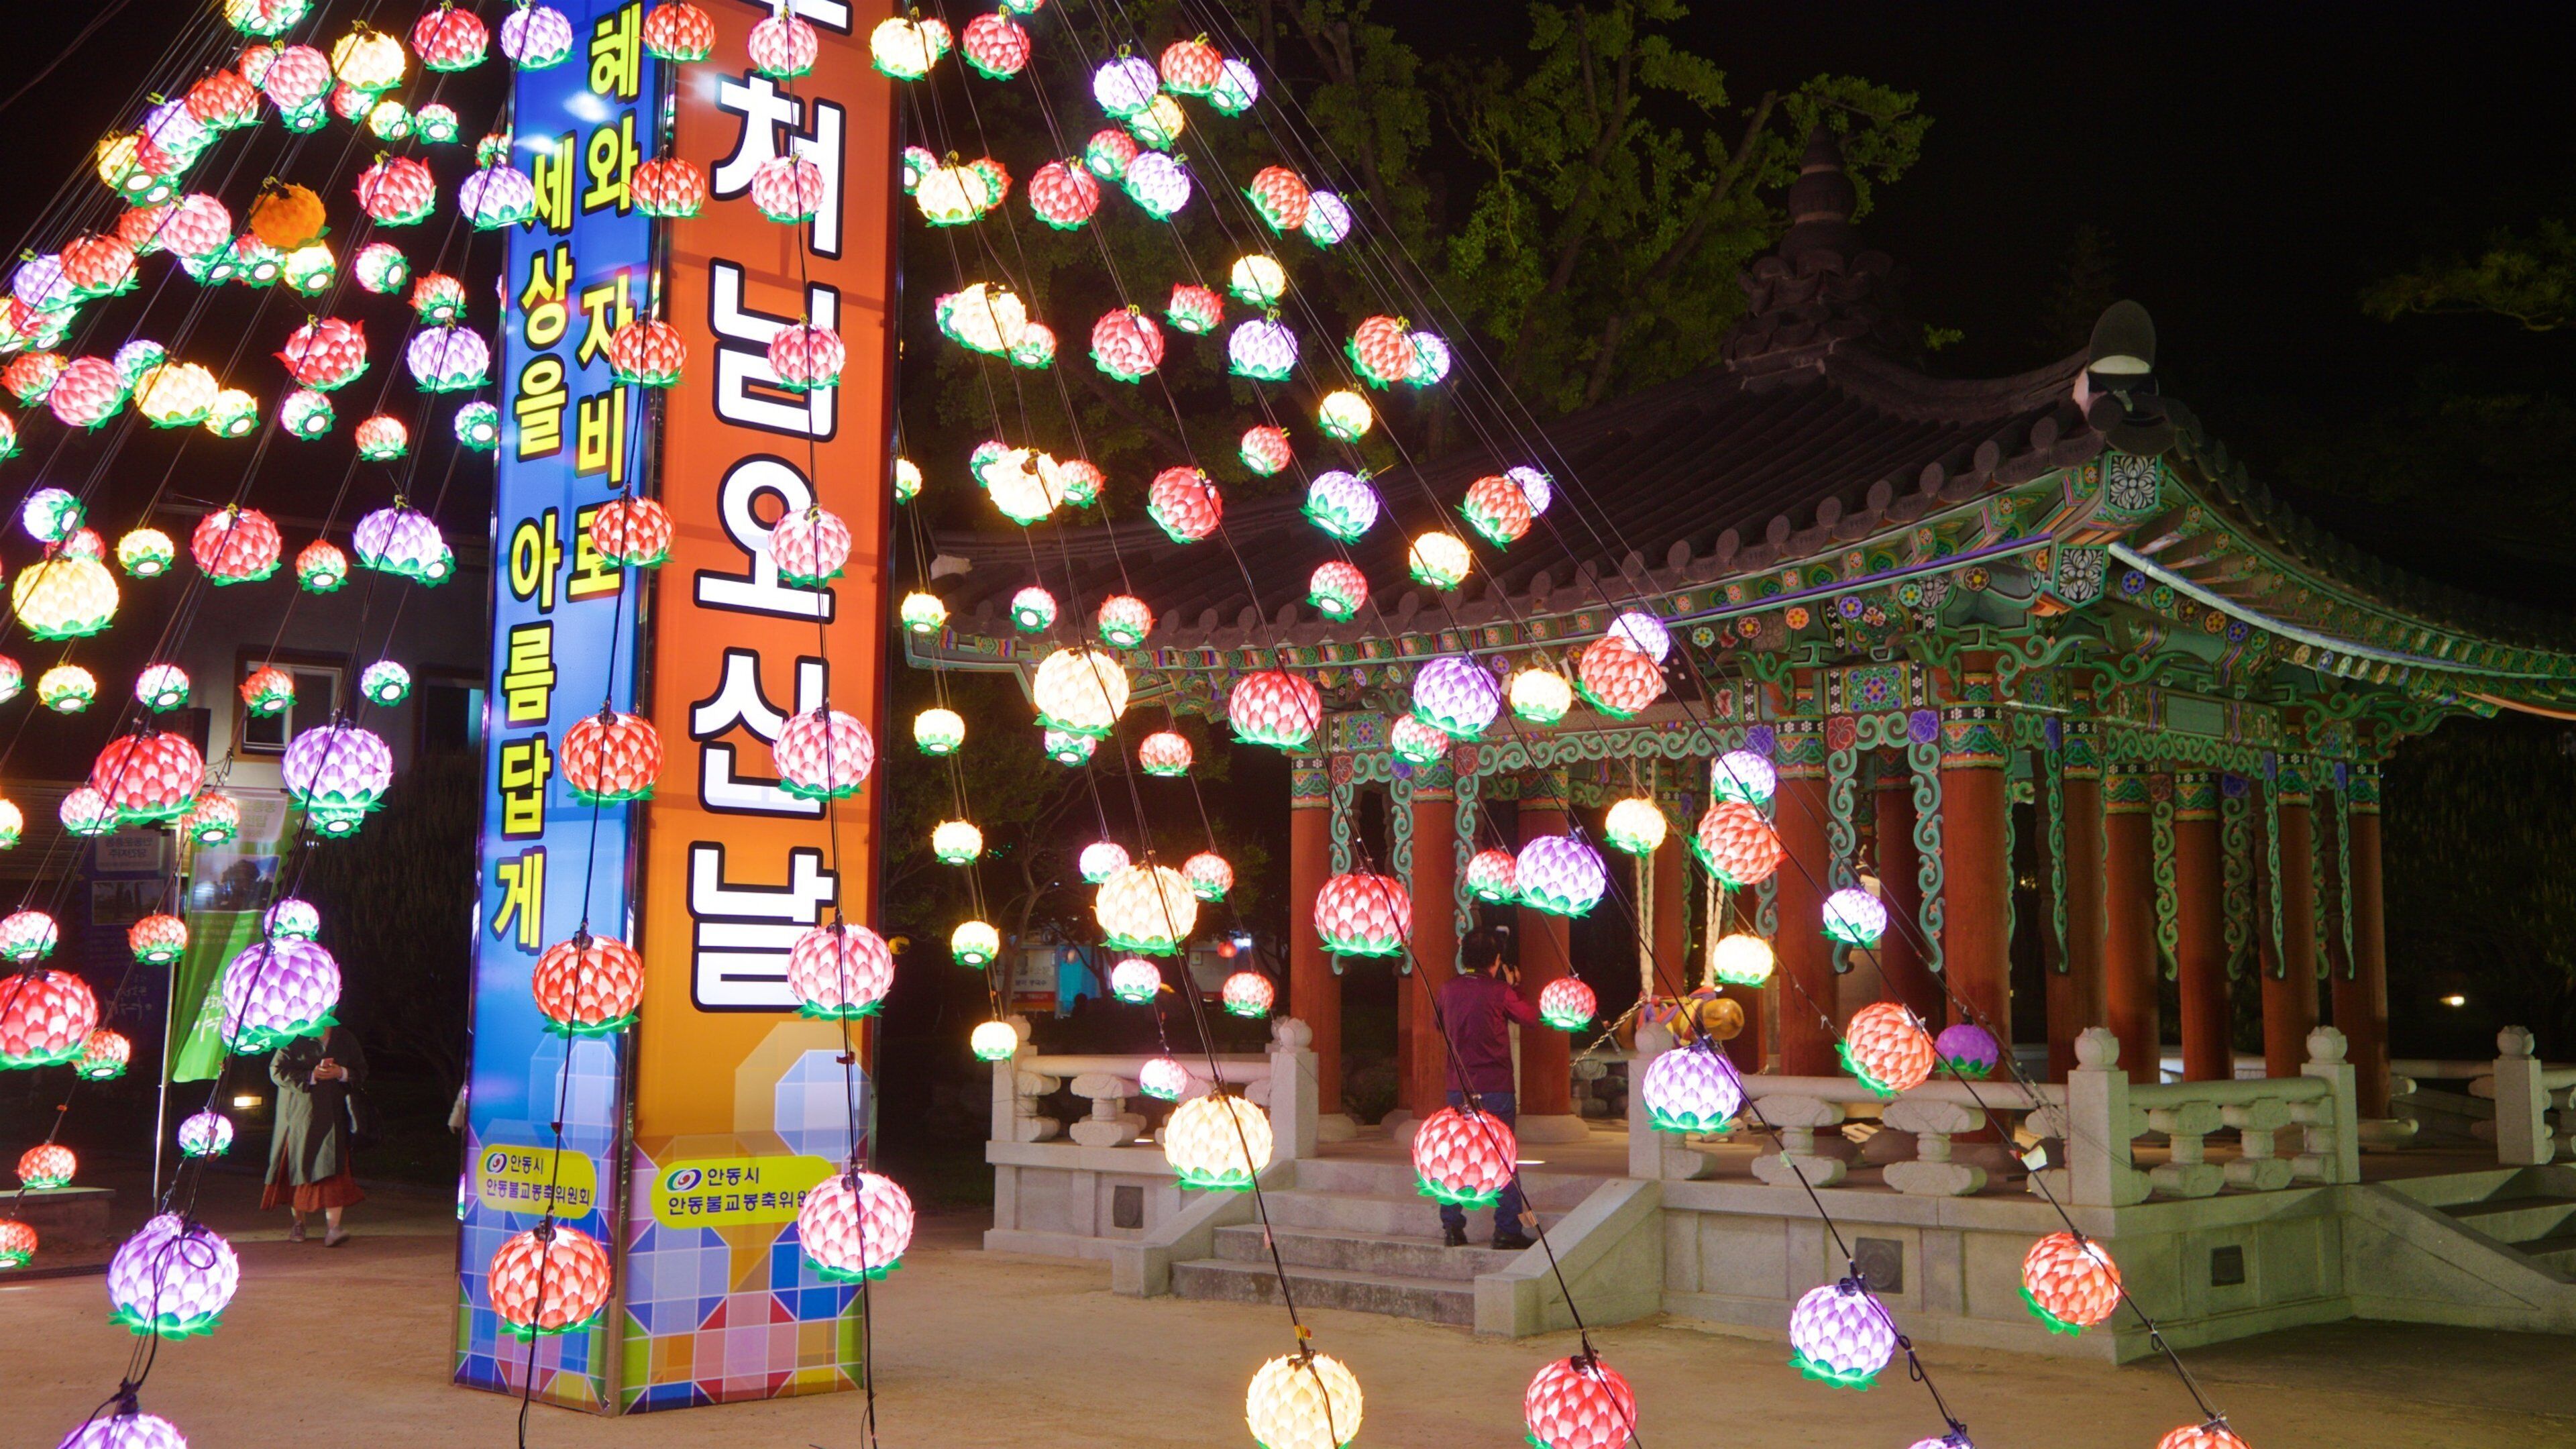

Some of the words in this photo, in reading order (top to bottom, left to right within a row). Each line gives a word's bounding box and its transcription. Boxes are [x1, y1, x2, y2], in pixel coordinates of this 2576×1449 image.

[515, 136, 574, 458] 세상을
[690, 0, 848, 1008] 처님오신날
[492, 514, 561, 949] 아름답게
[486, 1178, 590, 1207] 안동불교봉축위원회
[510, 1155, 543, 1175] 안동시
[707, 1167, 759, 1187] 안동시
